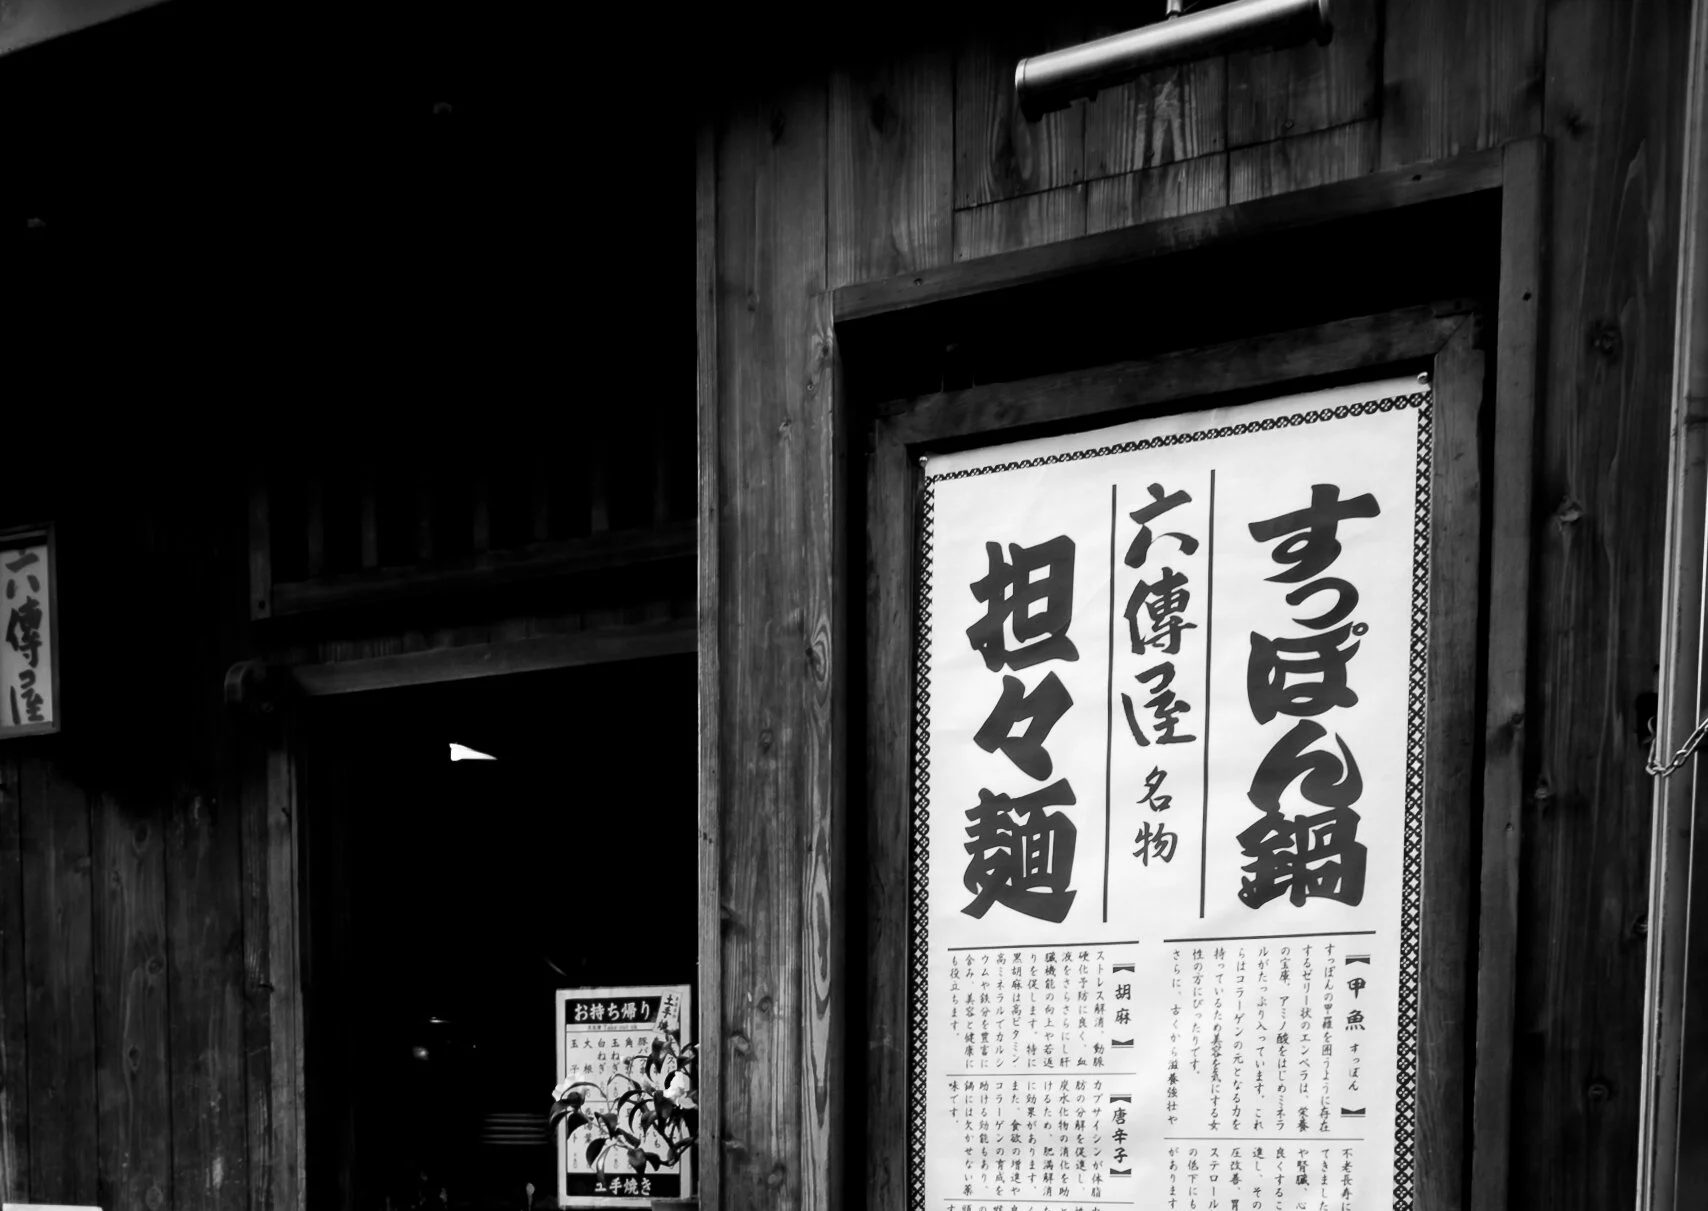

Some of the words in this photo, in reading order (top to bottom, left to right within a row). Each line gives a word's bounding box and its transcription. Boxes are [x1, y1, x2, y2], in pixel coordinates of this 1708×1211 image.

[1236, 483, 1381, 909] すっぽん鍋
[574, 1000, 650, 1021] お持ち帰り
